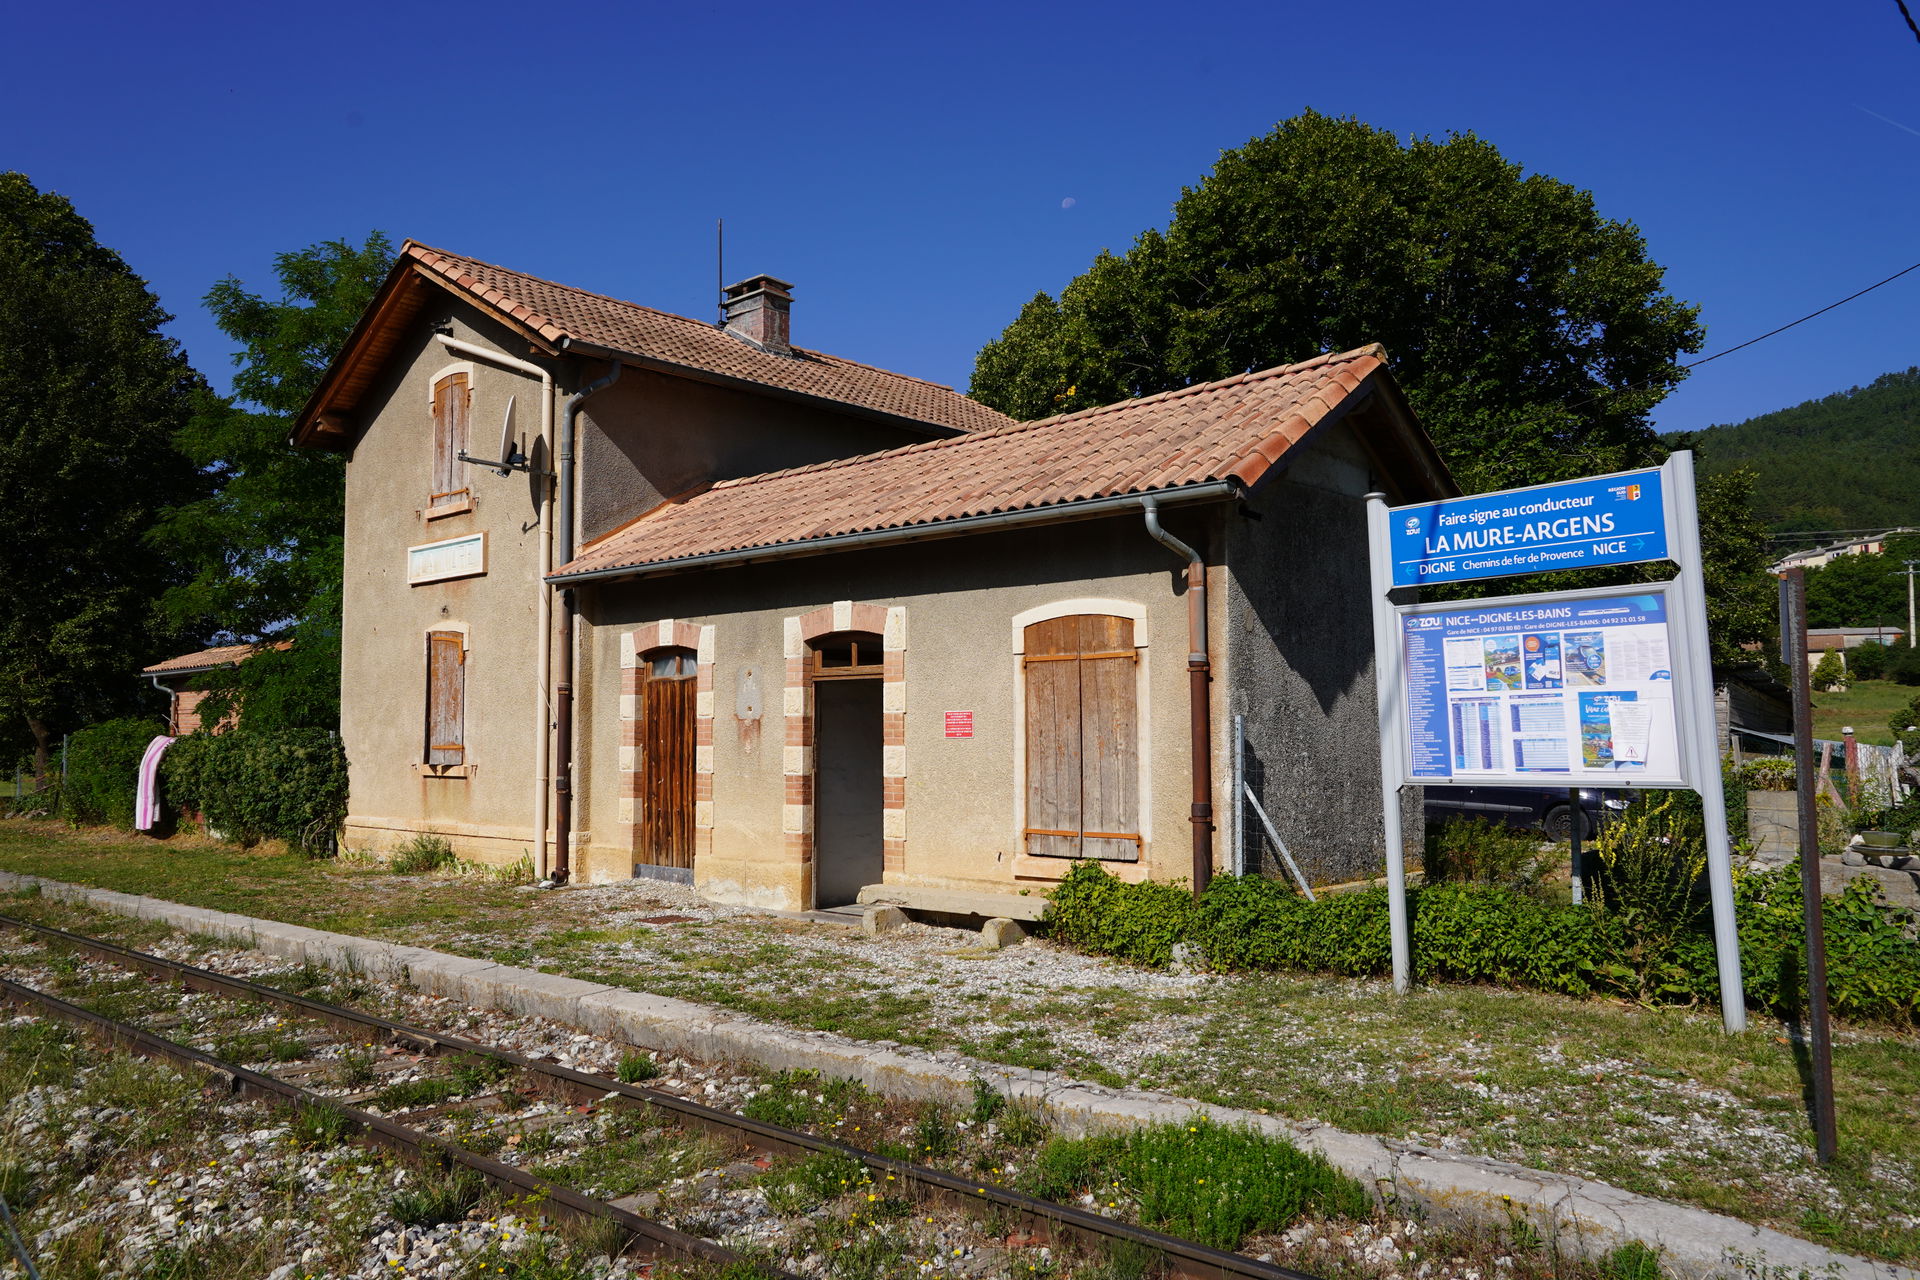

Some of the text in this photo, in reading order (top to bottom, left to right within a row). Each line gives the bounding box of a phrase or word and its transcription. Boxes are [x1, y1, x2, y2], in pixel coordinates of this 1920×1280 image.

[1439, 496, 1594, 527] Faire signe au conducteur
[1425, 512, 1615, 554] LA MURE-ARGENS
[1592, 541, 1627, 556] NICE
[1420, 561, 1456, 575] DIGNE
[1462, 550, 1584, 570] Chemins de fer de Provence
